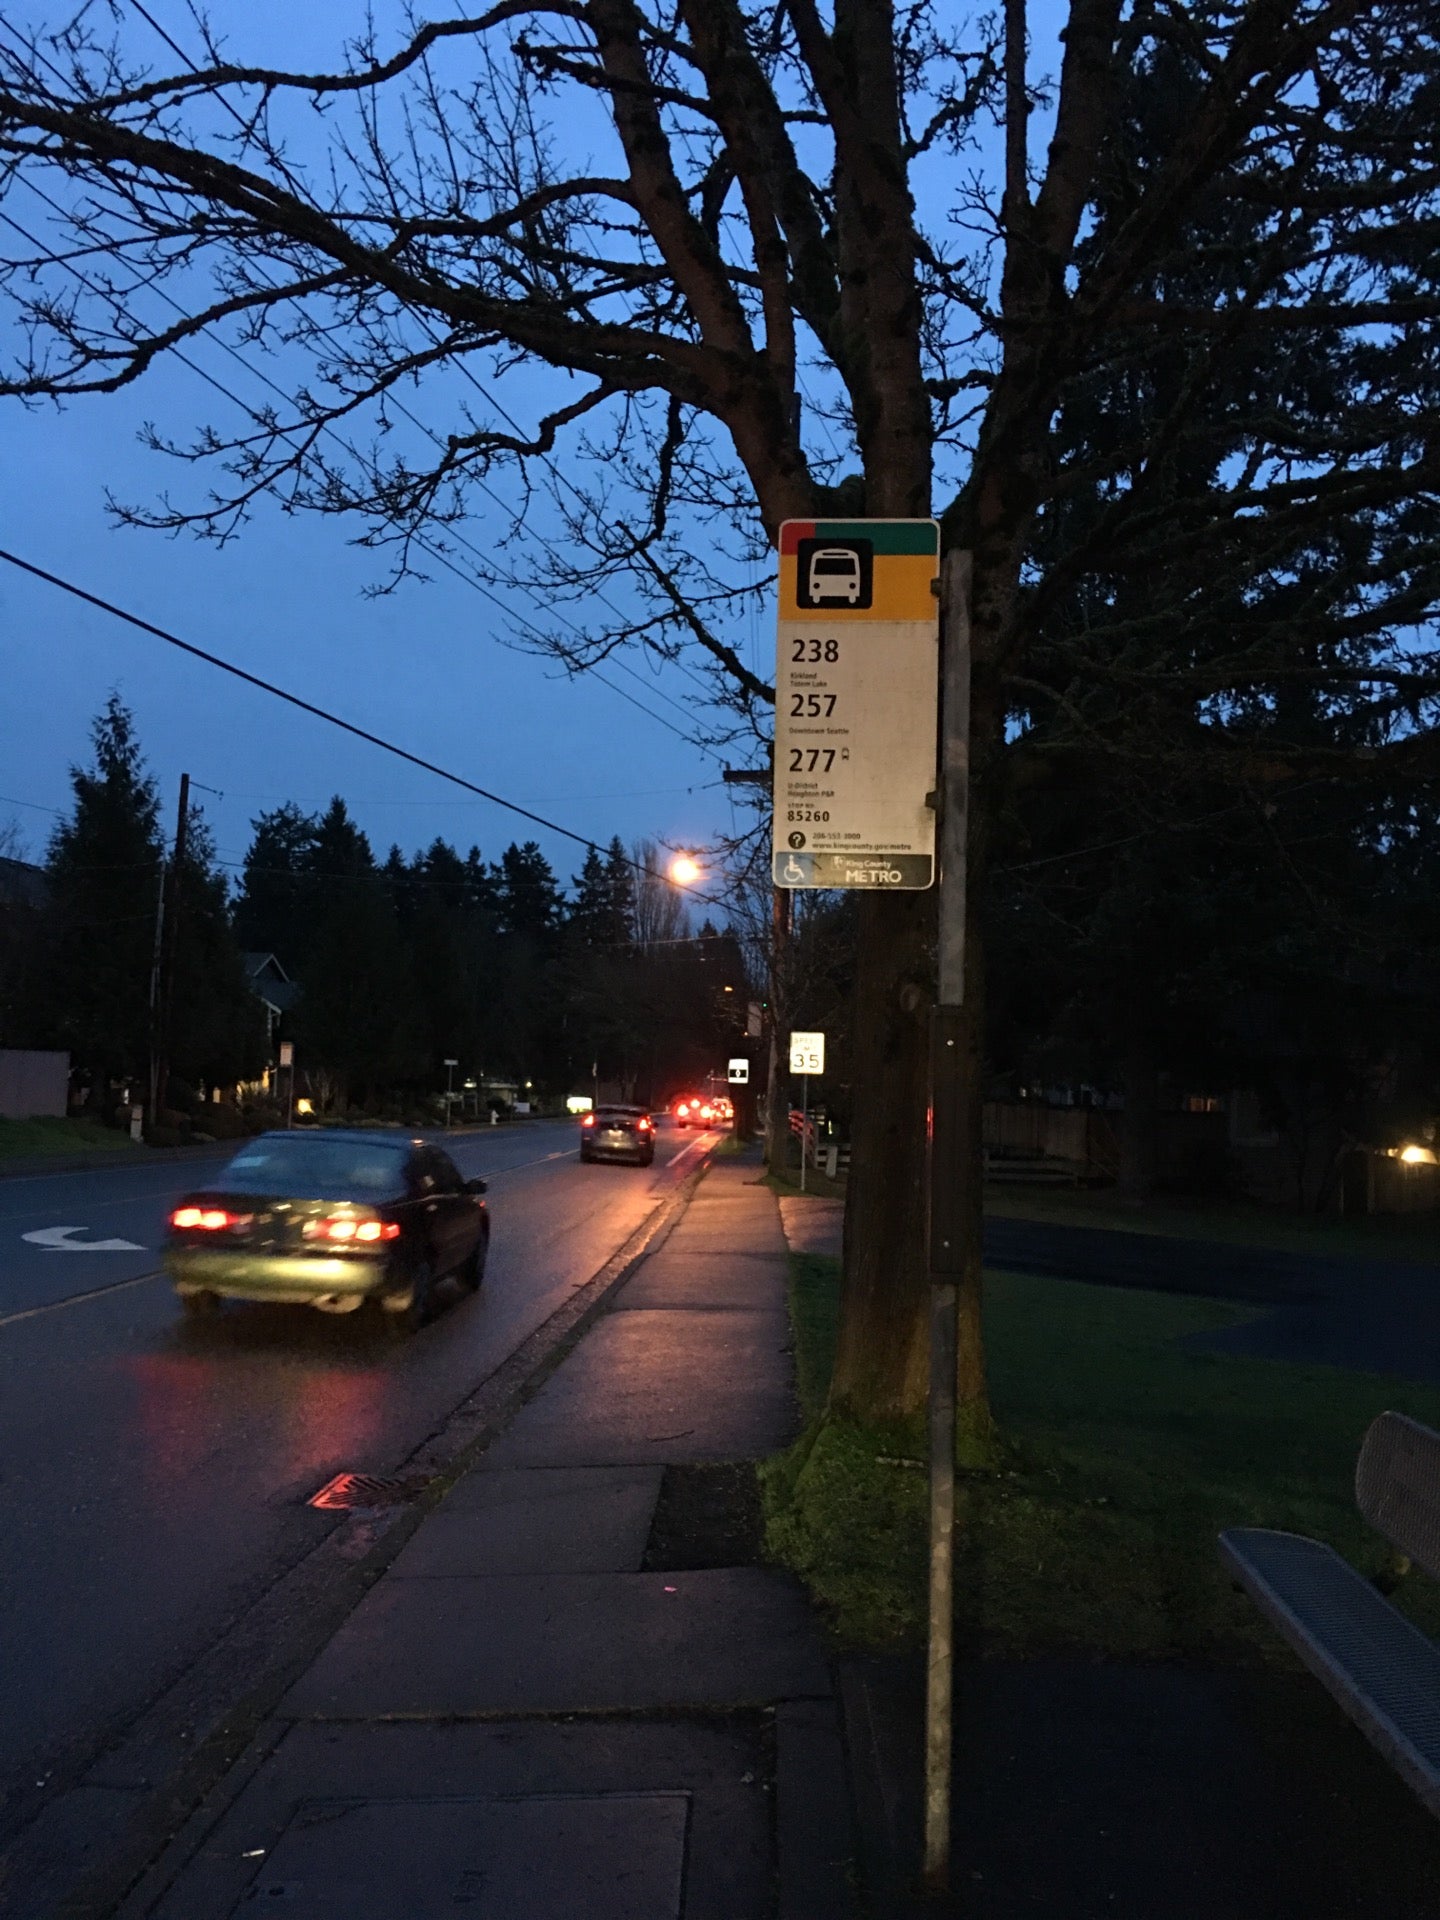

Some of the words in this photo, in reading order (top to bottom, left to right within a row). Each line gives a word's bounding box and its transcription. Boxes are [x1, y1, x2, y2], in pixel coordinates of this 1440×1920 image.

[792, 639, 839, 663] 238
[790, 693, 837, 717] 257
[789, 748, 836, 772] 277
[787, 810, 830, 822] 85260
[863, 860, 892, 869] County
[845, 870, 902, 883] METRO
[793, 1053, 820, 1068] 35
